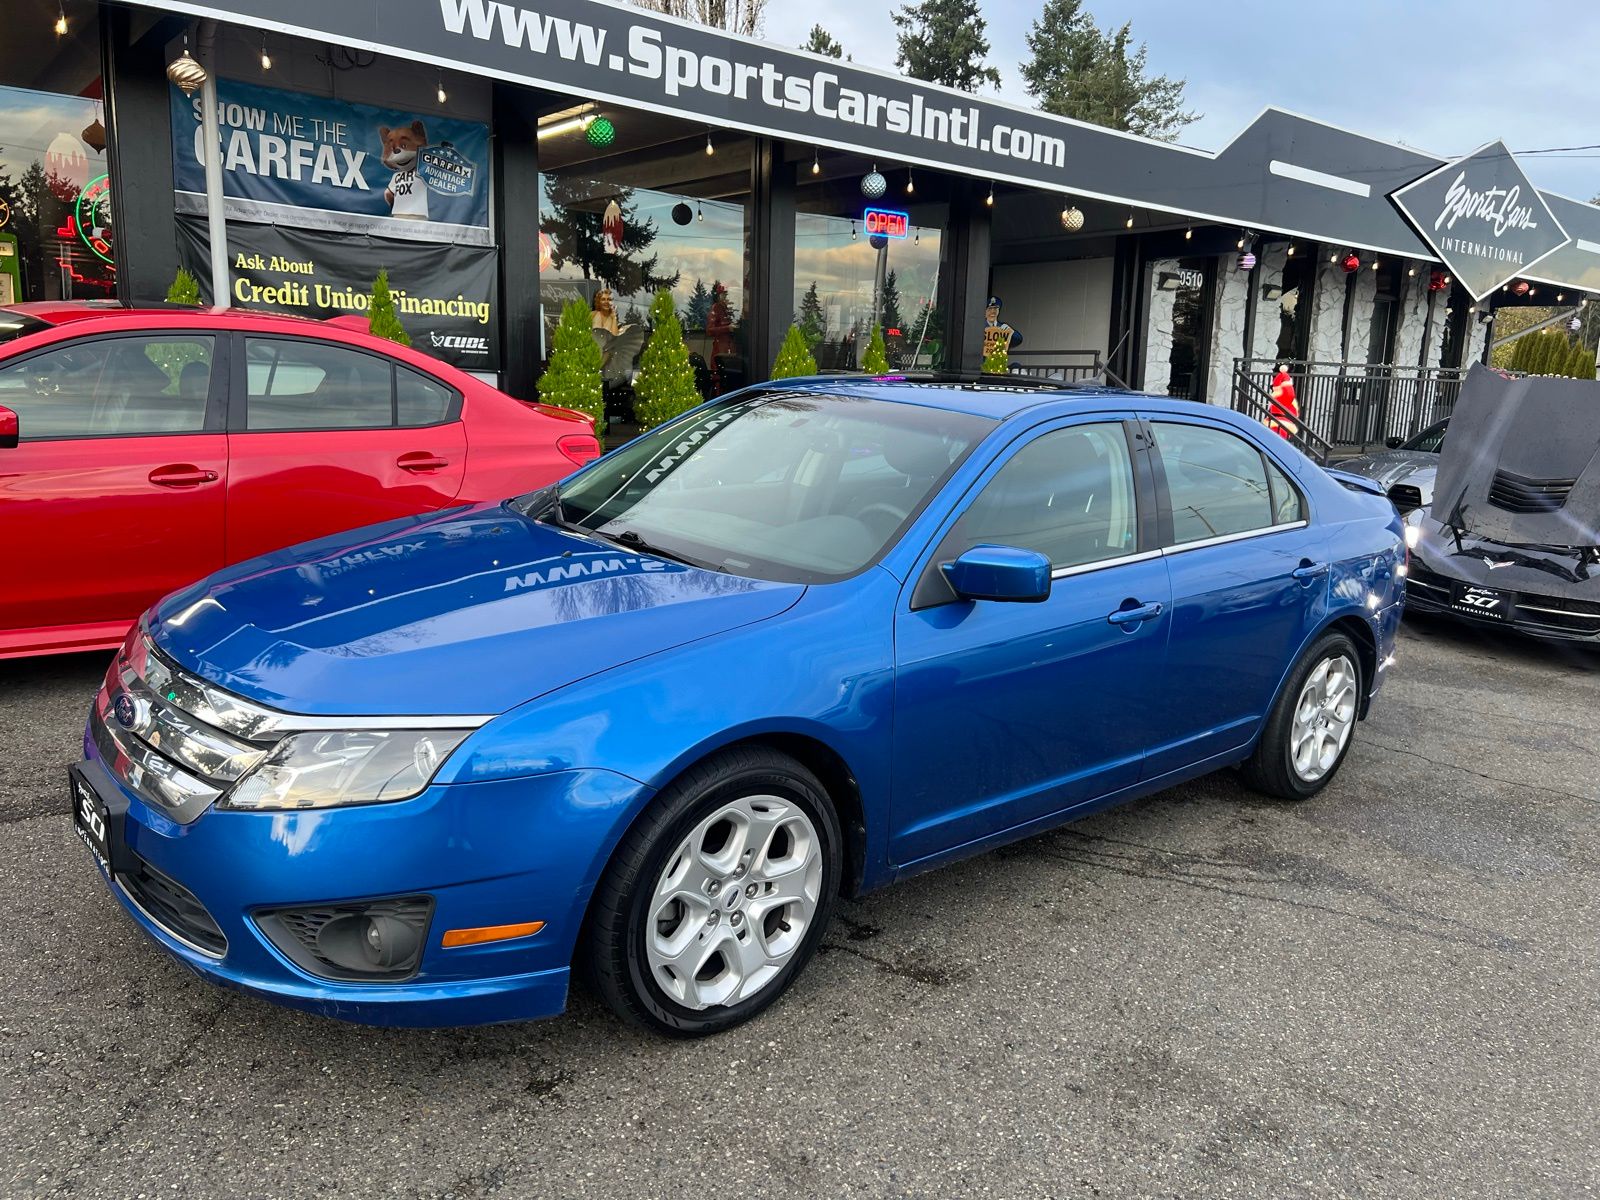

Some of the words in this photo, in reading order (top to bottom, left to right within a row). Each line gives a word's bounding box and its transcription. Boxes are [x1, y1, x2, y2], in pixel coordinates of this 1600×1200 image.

[192, 98, 266, 131] SHOW
[273, 112, 305, 138] ME
[309, 118, 347, 146] THE
[194, 124, 370, 191] CARFAX
[424, 154, 472, 178] CARFAX
[394, 171, 415, 183] CAR
[424, 166, 466, 187] ADVANTAGE
[428, 177, 457, 192] DEALER
[395, 183, 413, 196] FOX
[1434, 170, 1506, 230] Sports
[1494, 185, 1537, 238] Cars
[866, 212, 907, 236] OPEN
[1441, 237, 1524, 264] INTERNATIONAL
[235, 253, 266, 271] Ask
[269, 256, 314, 275] About
[1176, 270, 1203, 288] 0510
[235, 277, 309, 306] Credit
[388, 289, 490, 324] Financing
[443, 336, 488, 349] CUDL
[1451, 604, 1501, 619] INTERNATIONAL
[1459, 594, 1500, 608] SCI
[81, 799, 105, 842] SCI
